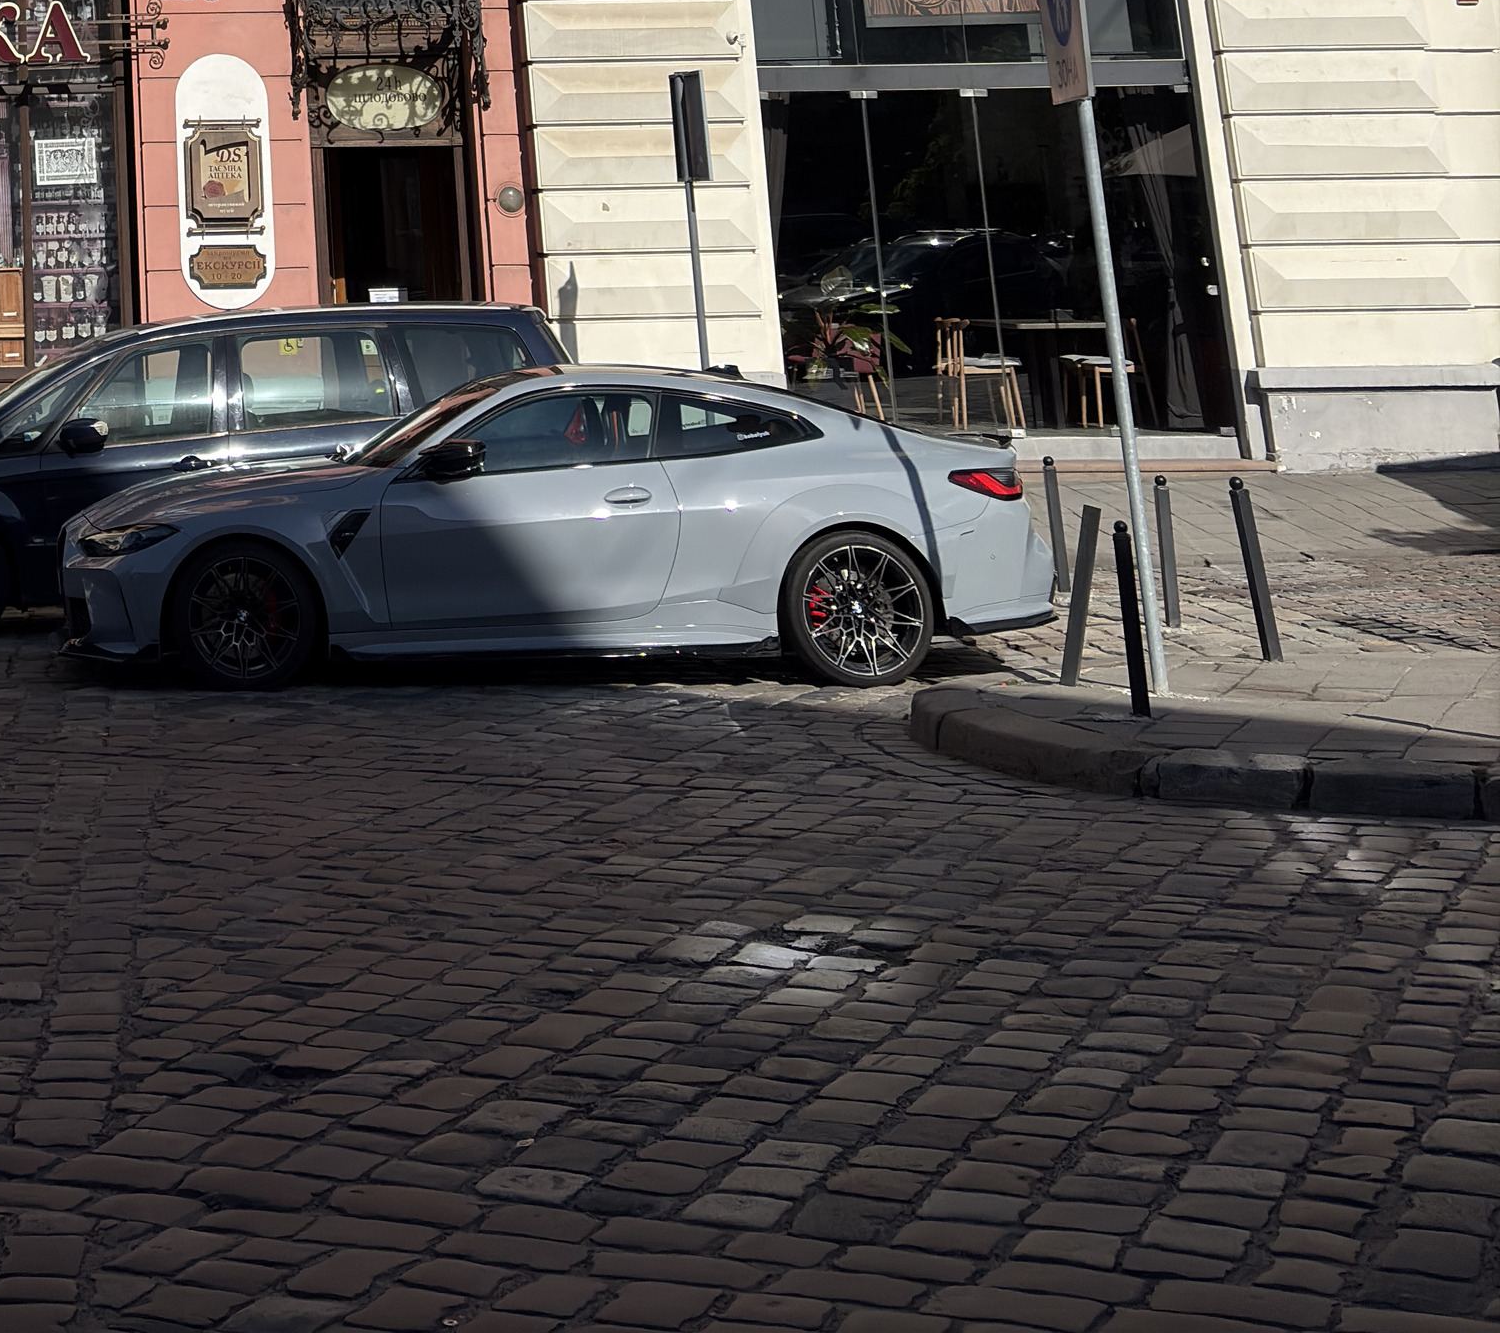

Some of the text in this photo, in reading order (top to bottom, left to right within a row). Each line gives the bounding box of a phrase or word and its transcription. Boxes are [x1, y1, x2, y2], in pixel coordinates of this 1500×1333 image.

[353, 92, 427, 104] ЦІЛОДОБОВО
[216, 148, 243, 163] D.S.
[197, 259, 261, 270] ЕКСКУРСІЇ
